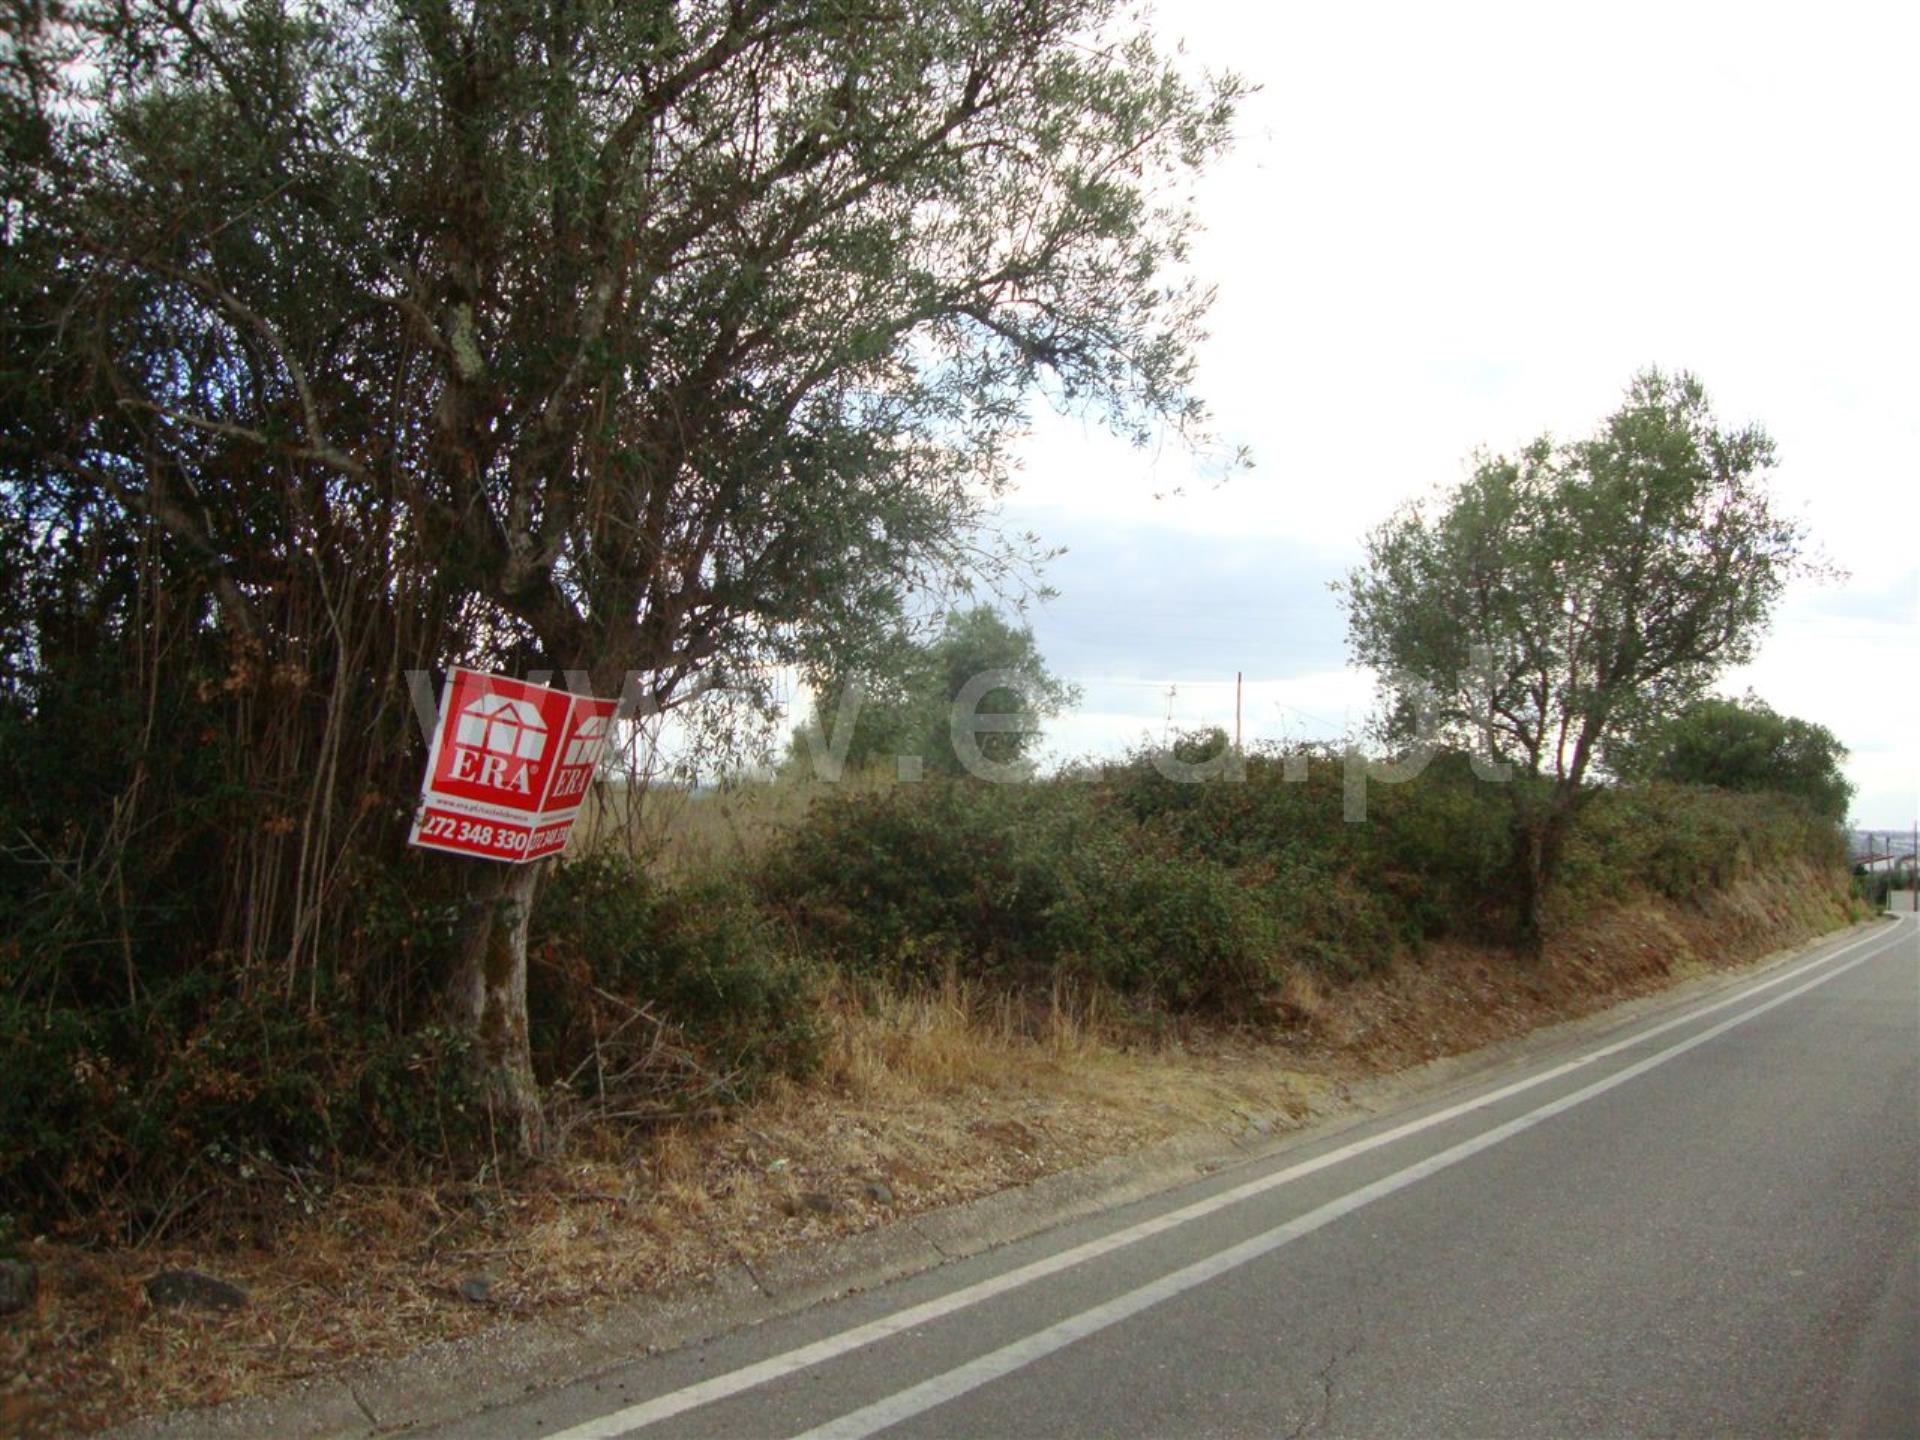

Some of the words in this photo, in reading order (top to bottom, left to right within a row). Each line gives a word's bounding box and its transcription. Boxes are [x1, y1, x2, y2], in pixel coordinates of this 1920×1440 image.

[448, 747, 531, 795] ERA
[421, 815, 457, 839] 272
[457, 821, 494, 845] 348
[494, 828, 528, 851] 330
